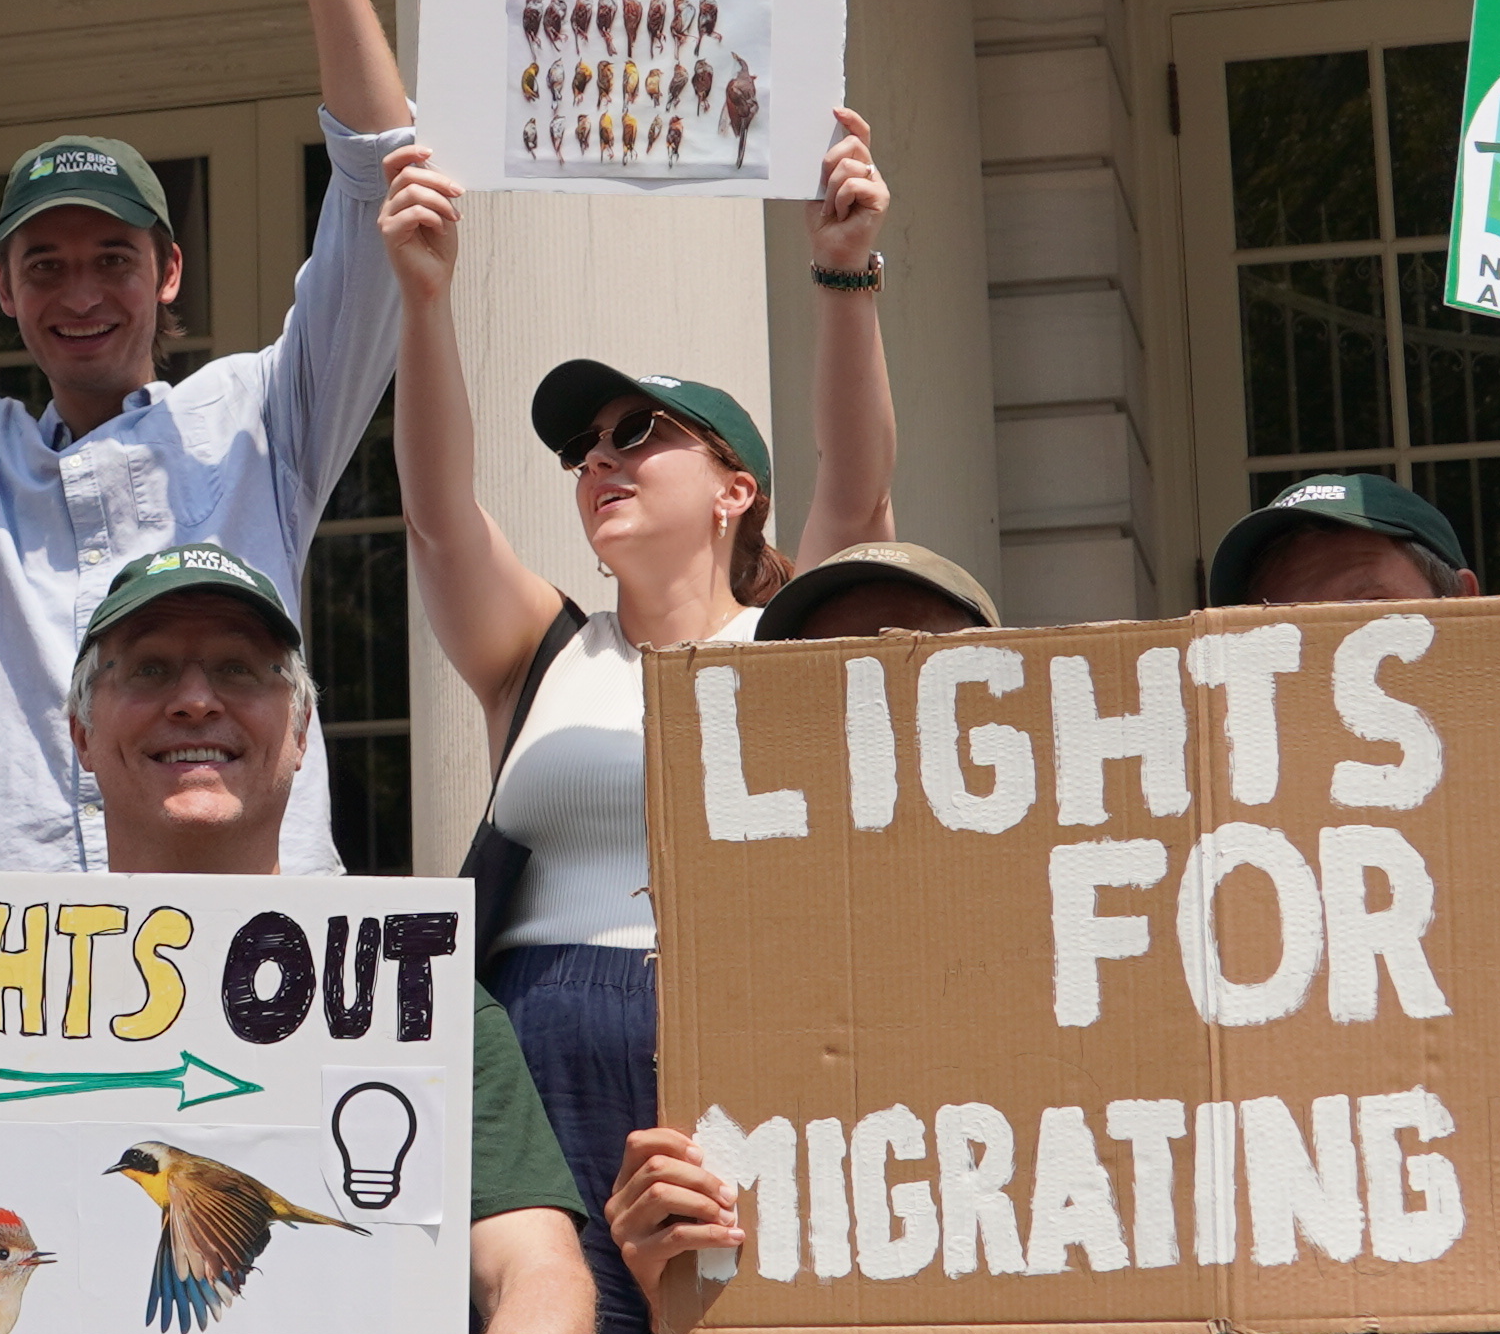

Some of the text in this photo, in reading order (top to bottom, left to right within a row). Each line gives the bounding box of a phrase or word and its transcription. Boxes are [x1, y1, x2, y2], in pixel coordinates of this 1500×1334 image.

[55, 151, 117, 166] NYC BIRD
[55, 163, 118, 175] ALLIANCE
[183, 550, 220, 563] NYC
[693, 612, 1445, 843] LIGHTS
[221, 911, 459, 1044] OUT
[1048, 820, 1453, 1029] FOR
[693, 1085, 1466, 1282] MIGRATING
